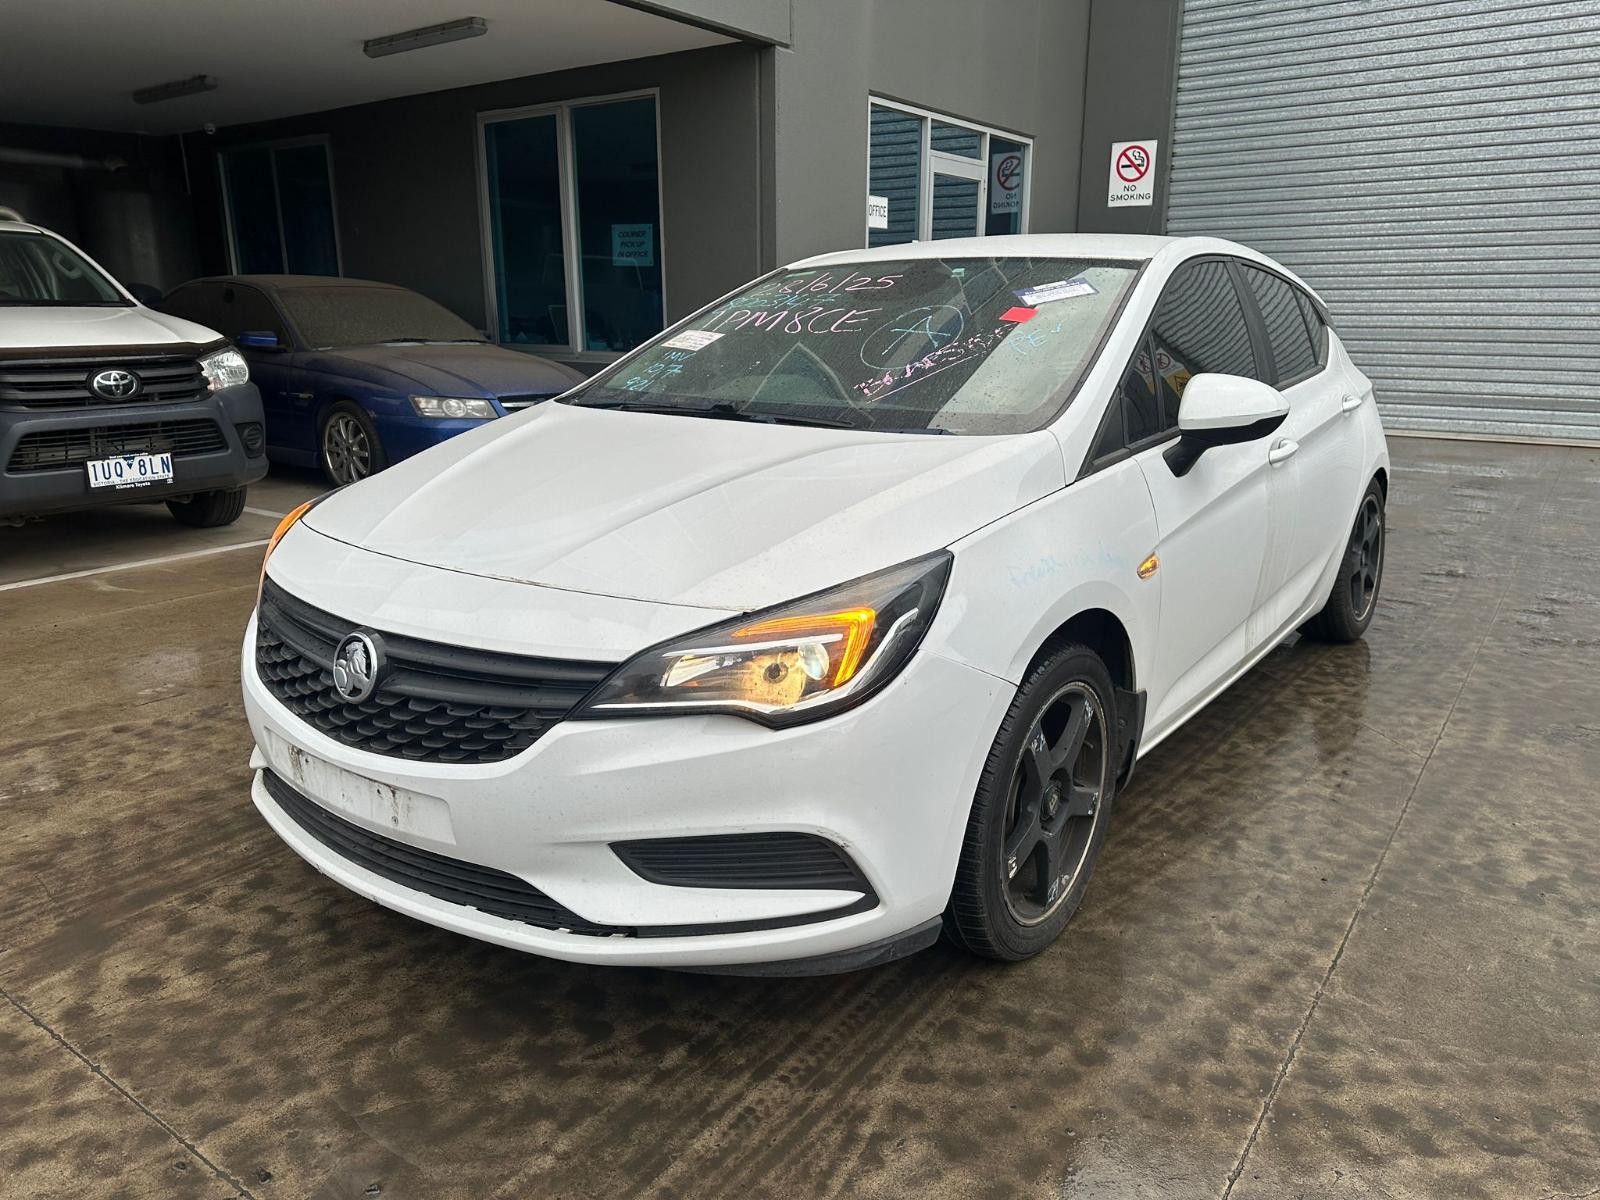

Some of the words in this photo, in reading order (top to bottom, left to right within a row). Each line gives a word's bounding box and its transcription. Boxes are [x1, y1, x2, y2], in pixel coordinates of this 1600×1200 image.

[1123, 184, 1137, 192] NO
[1110, 193, 1151, 201] SMOKING
[869, 204, 886, 218] OFFICE
[91, 461, 124, 482] 1UQ
[138, 455, 171, 476] 8LN
